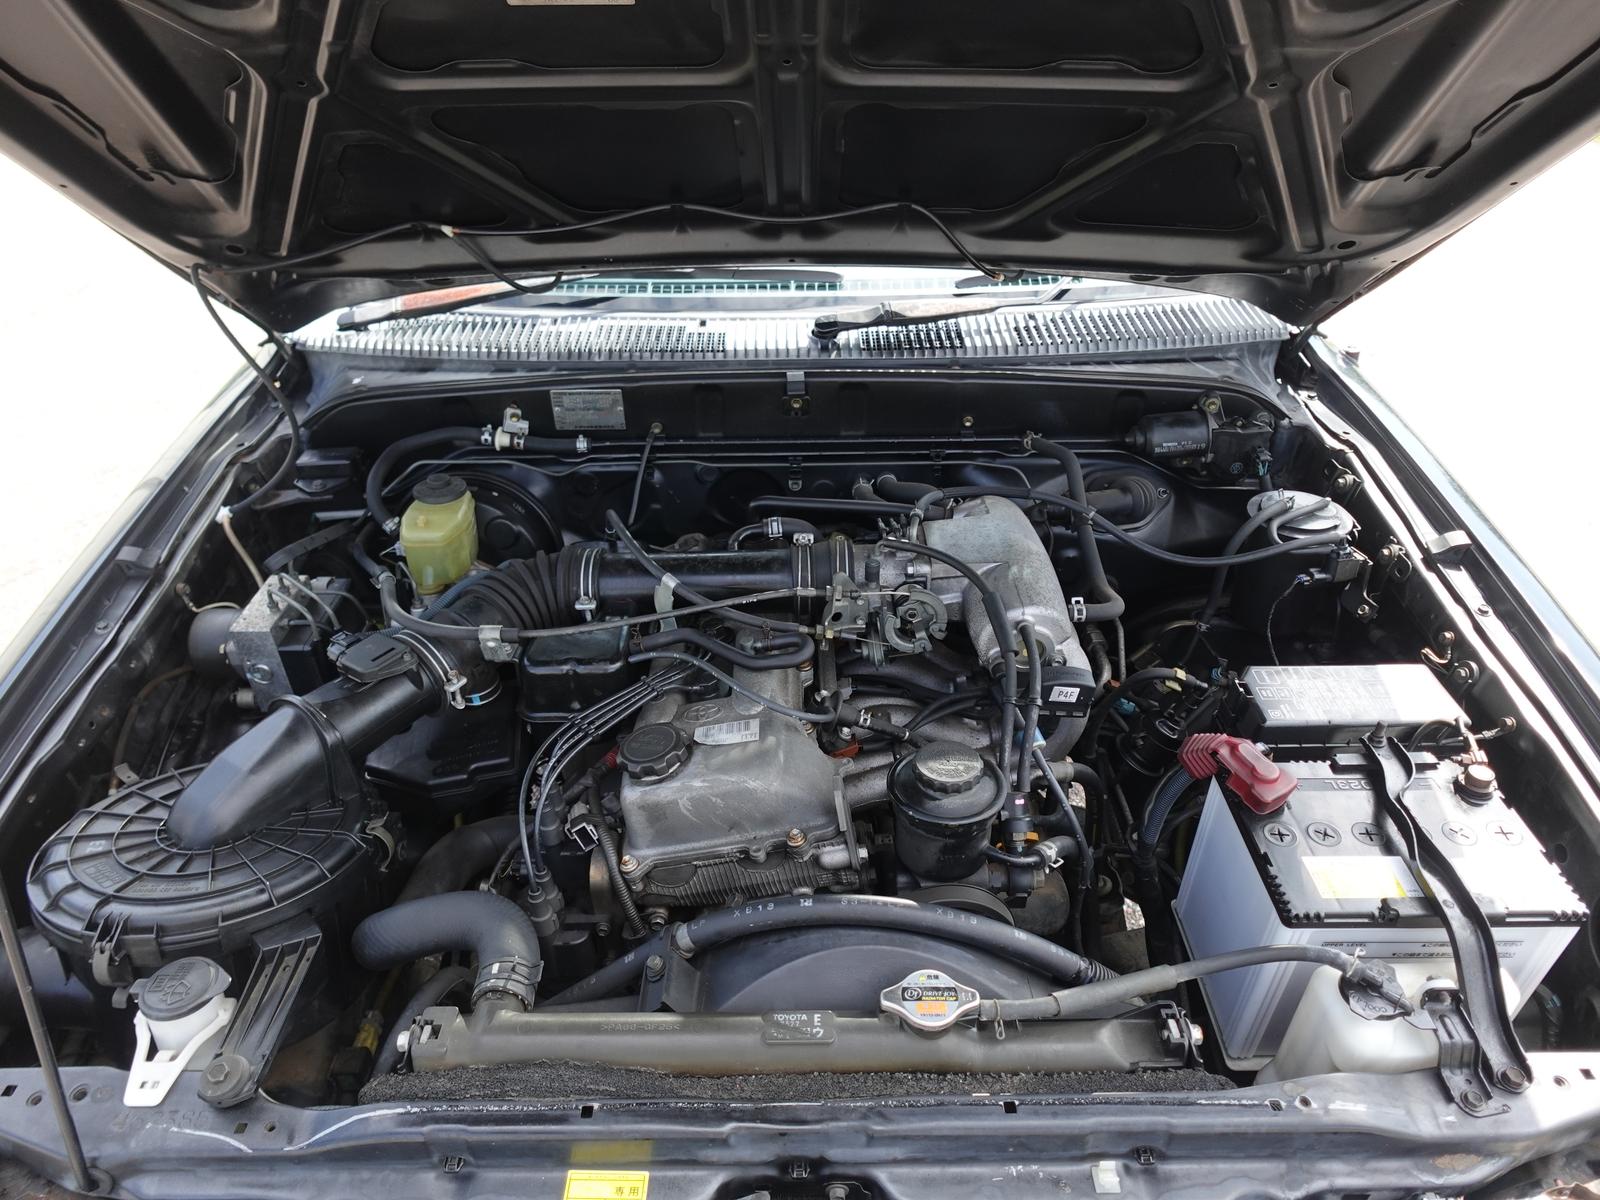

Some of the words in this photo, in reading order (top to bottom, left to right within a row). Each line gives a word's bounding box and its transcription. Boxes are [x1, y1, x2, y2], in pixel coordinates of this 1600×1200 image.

[1057, 690, 1075, 699] P4F
[773, 1013, 808, 1021] TOYOTA
[814, 1014, 822, 1026] E
